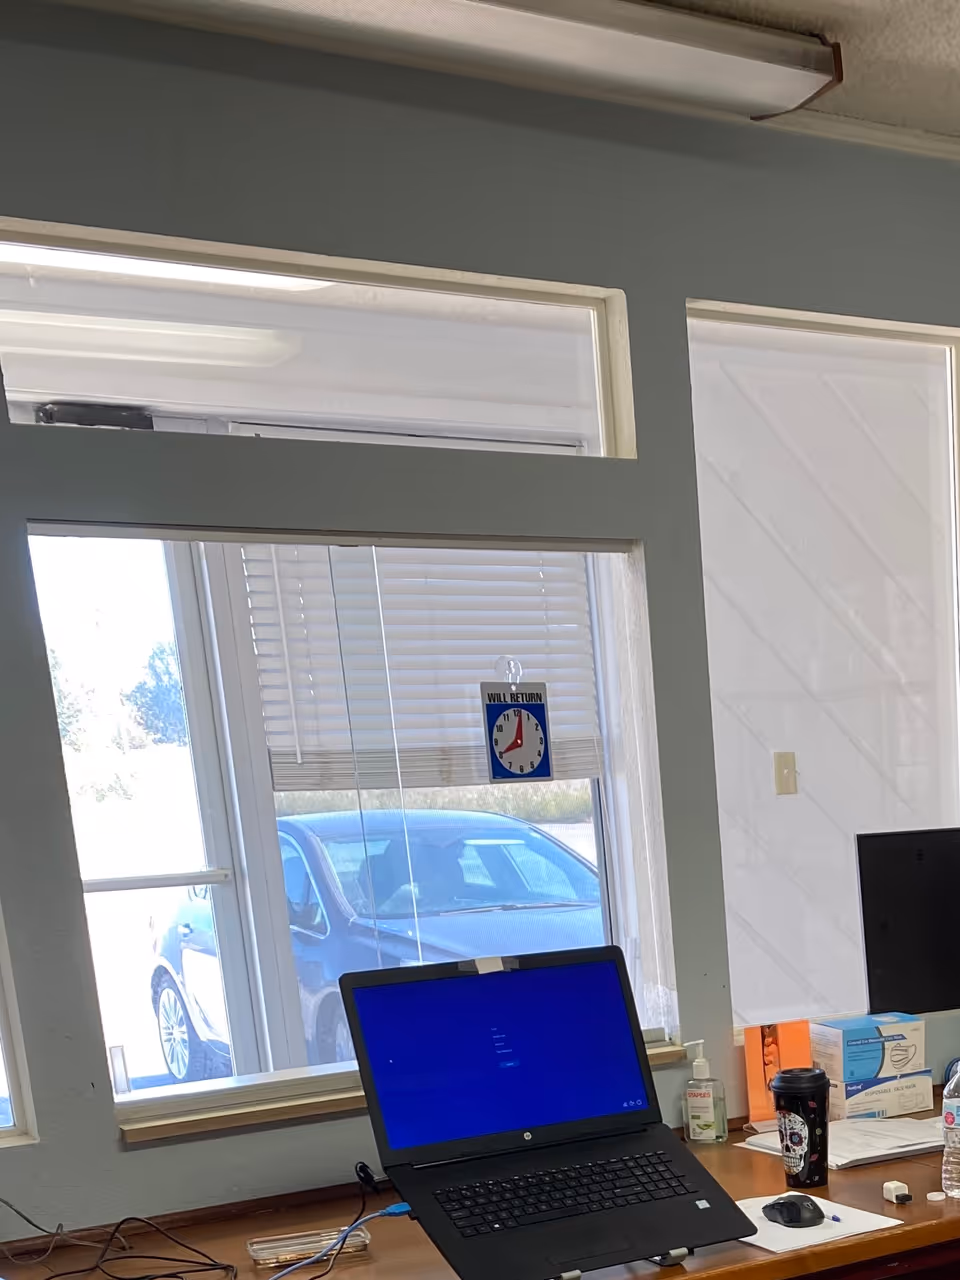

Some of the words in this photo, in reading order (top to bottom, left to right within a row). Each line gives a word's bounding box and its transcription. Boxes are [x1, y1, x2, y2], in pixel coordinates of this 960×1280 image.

[488, 692, 508, 703] WILL
[510, 692, 542, 703] RETURN
[503, 713, 510, 722] 11
[496, 724, 504, 732] 10
[535, 723, 540, 731] 2
[508, 762, 512, 770] 7
